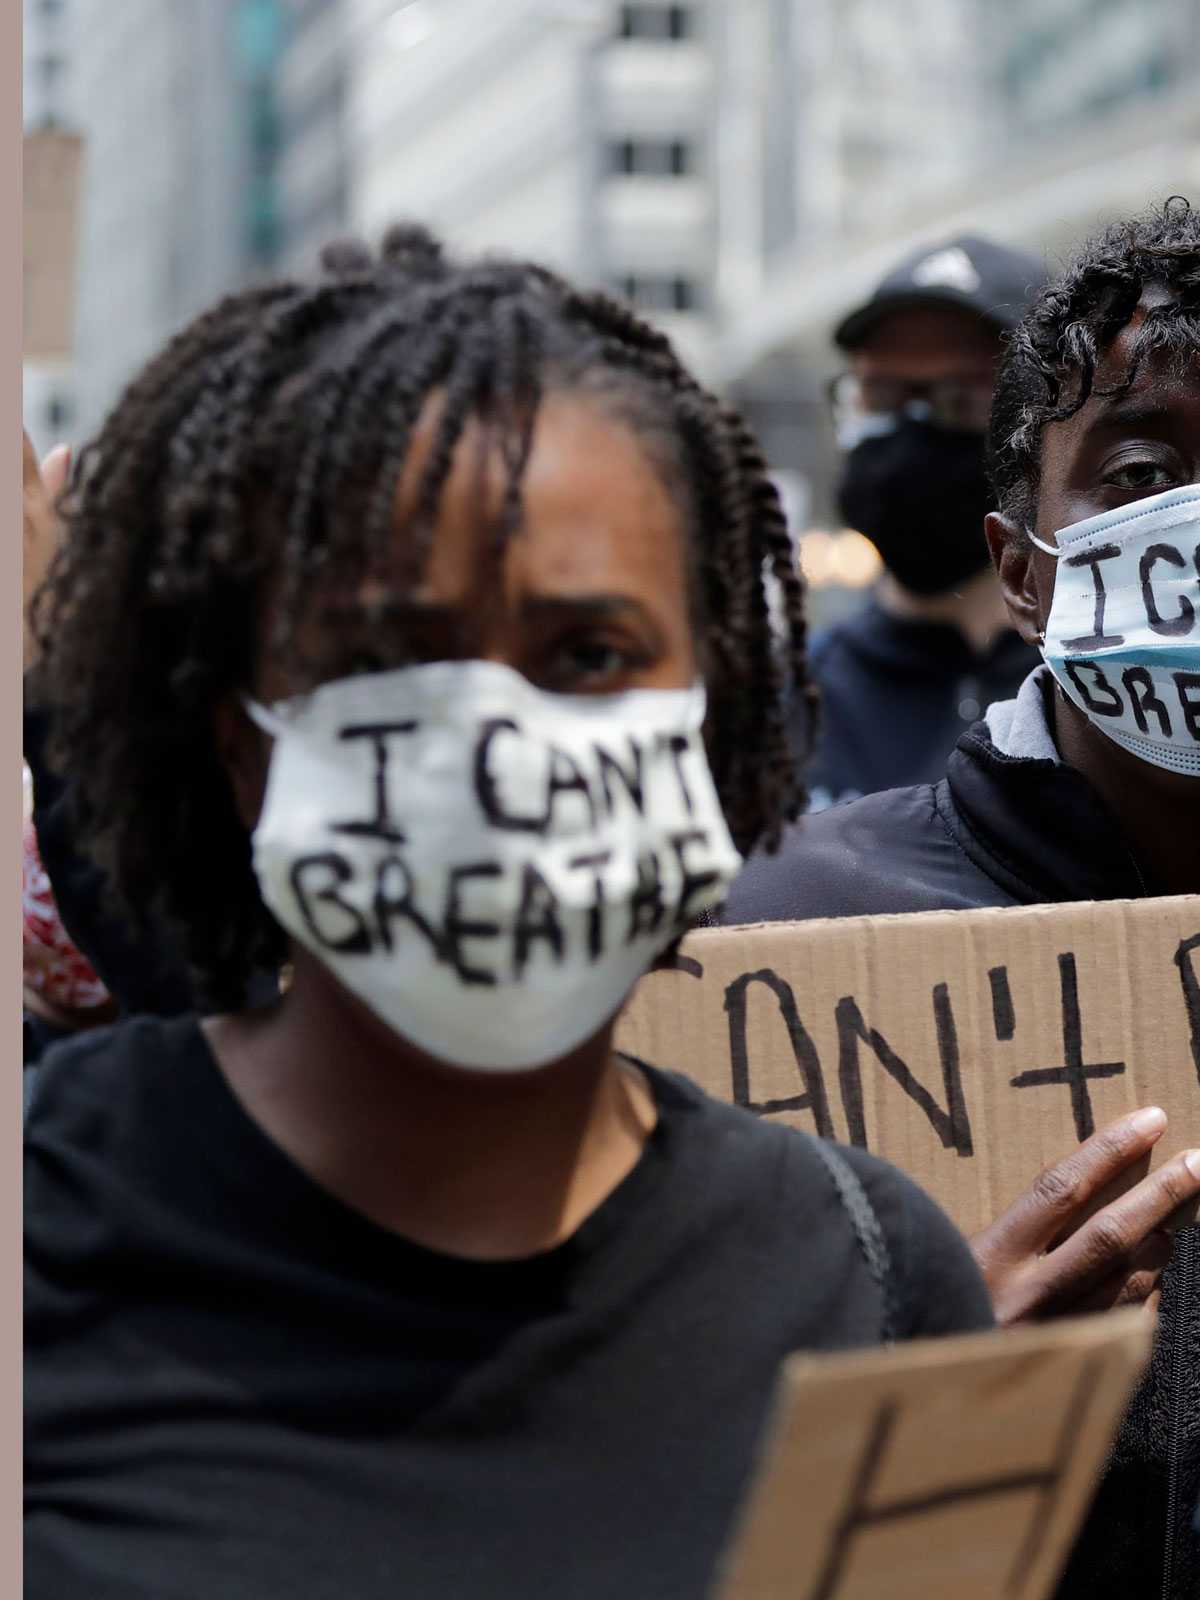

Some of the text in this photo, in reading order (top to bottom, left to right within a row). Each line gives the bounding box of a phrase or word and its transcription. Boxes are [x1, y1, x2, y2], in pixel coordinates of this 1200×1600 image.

[1060, 542, 1125, 651] I
[329, 718, 421, 844] I
[288, 832, 722, 987] BREATHE
[655, 952, 1126, 1157] AN't
